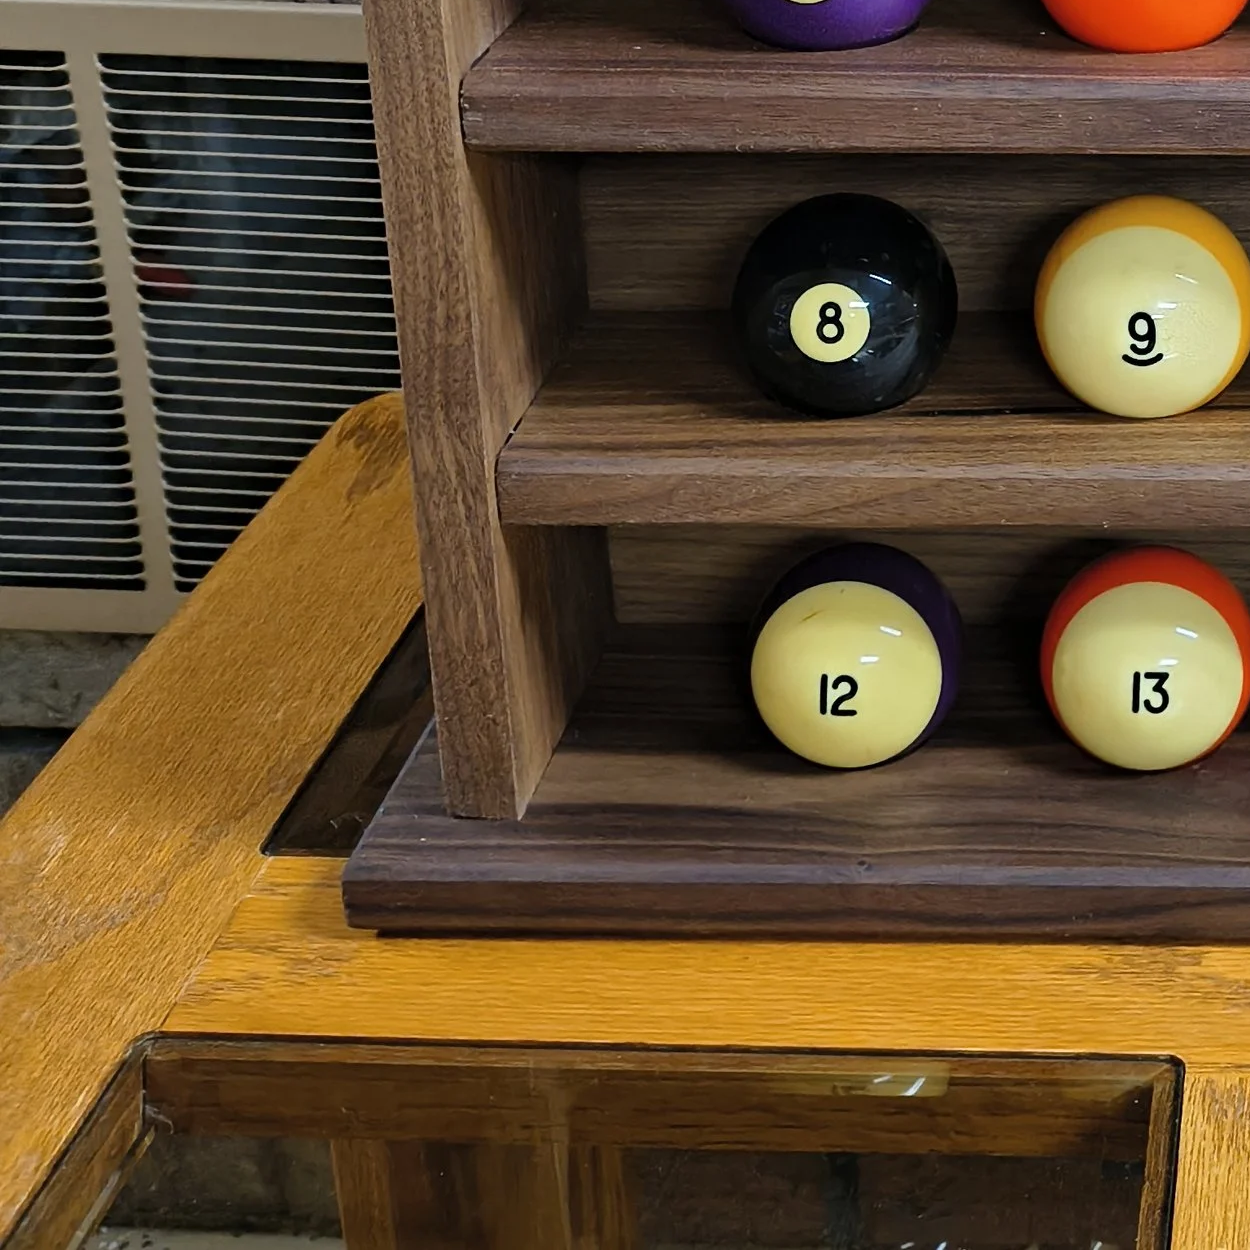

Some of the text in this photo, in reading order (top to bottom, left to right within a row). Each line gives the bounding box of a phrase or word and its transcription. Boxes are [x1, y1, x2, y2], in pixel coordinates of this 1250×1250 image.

[815, 301, 845, 345] 8
[1121, 311, 1164, 367] 9
[819, 673, 859, 717] 12
[1131, 671, 1170, 715] 13
